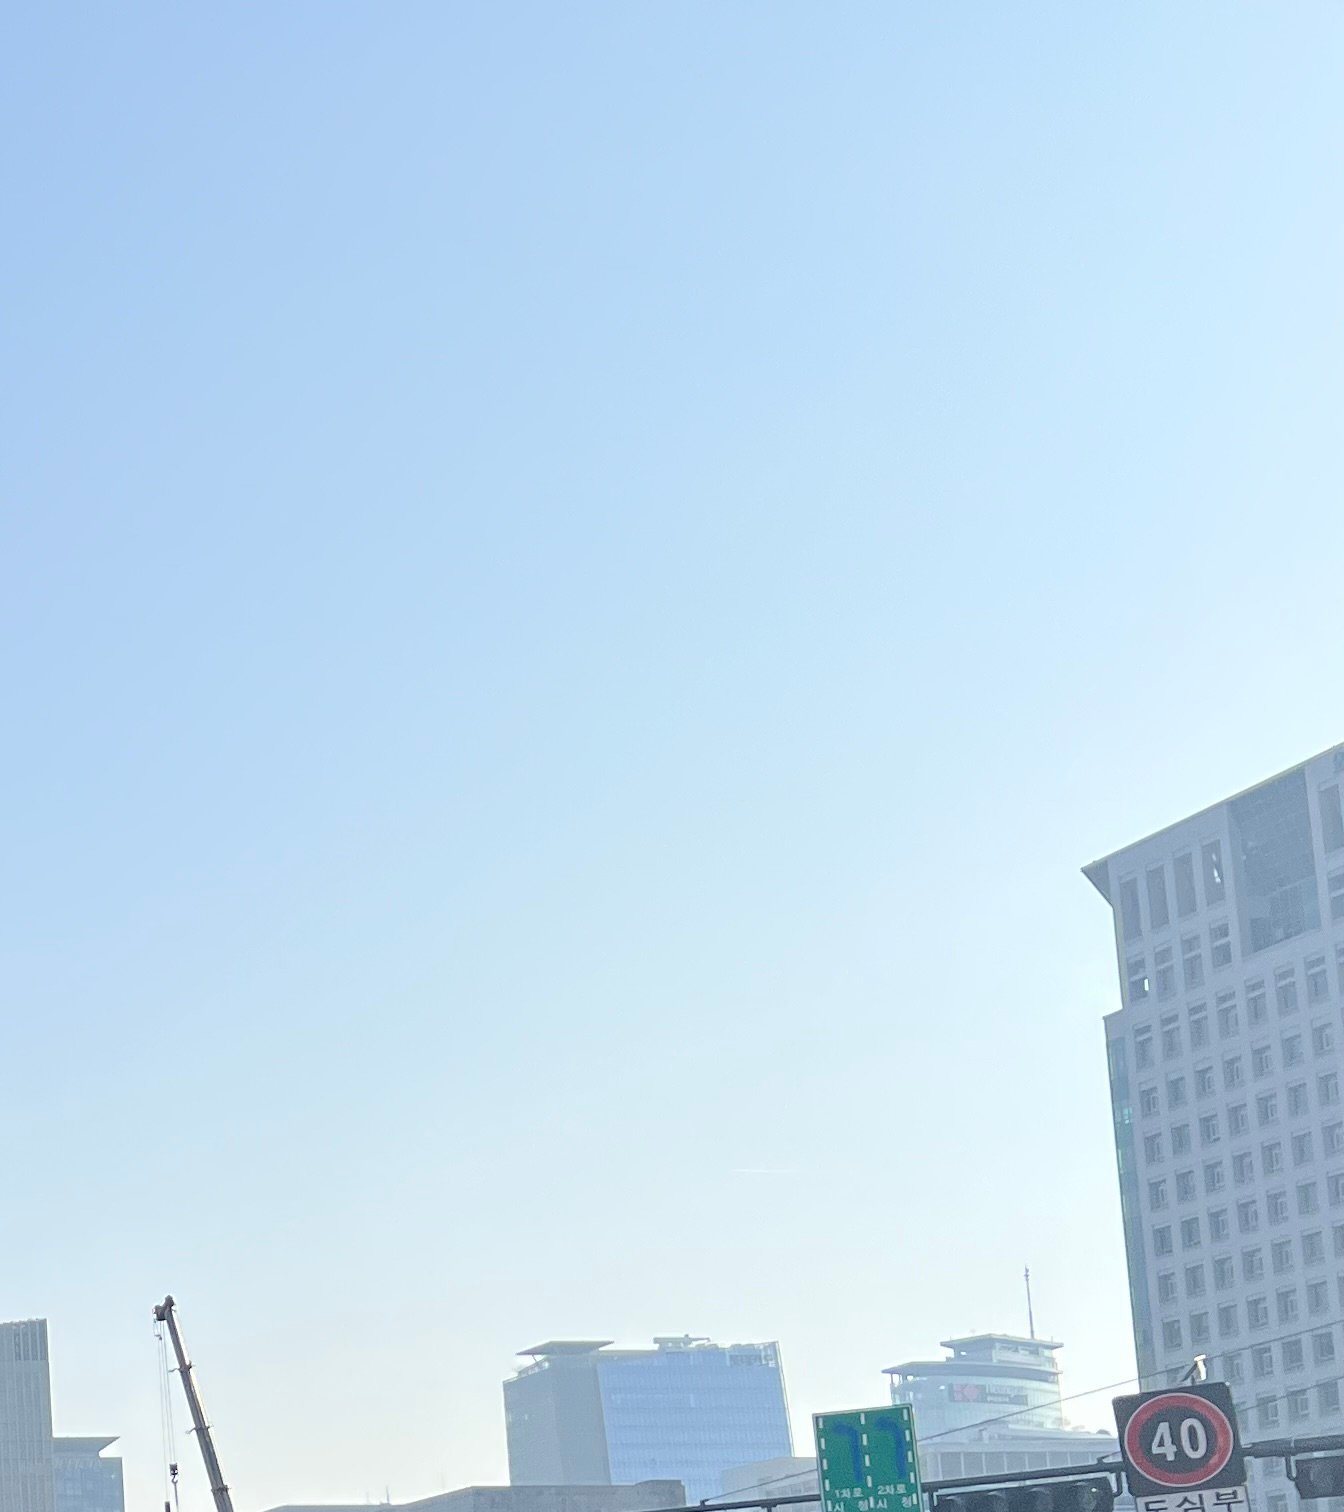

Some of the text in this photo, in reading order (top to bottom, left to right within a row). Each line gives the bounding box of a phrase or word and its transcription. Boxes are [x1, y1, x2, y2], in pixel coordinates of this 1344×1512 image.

[1151, 1418, 1208, 1462] 40
[834, 1484, 907, 1499] 1차로 2차로
